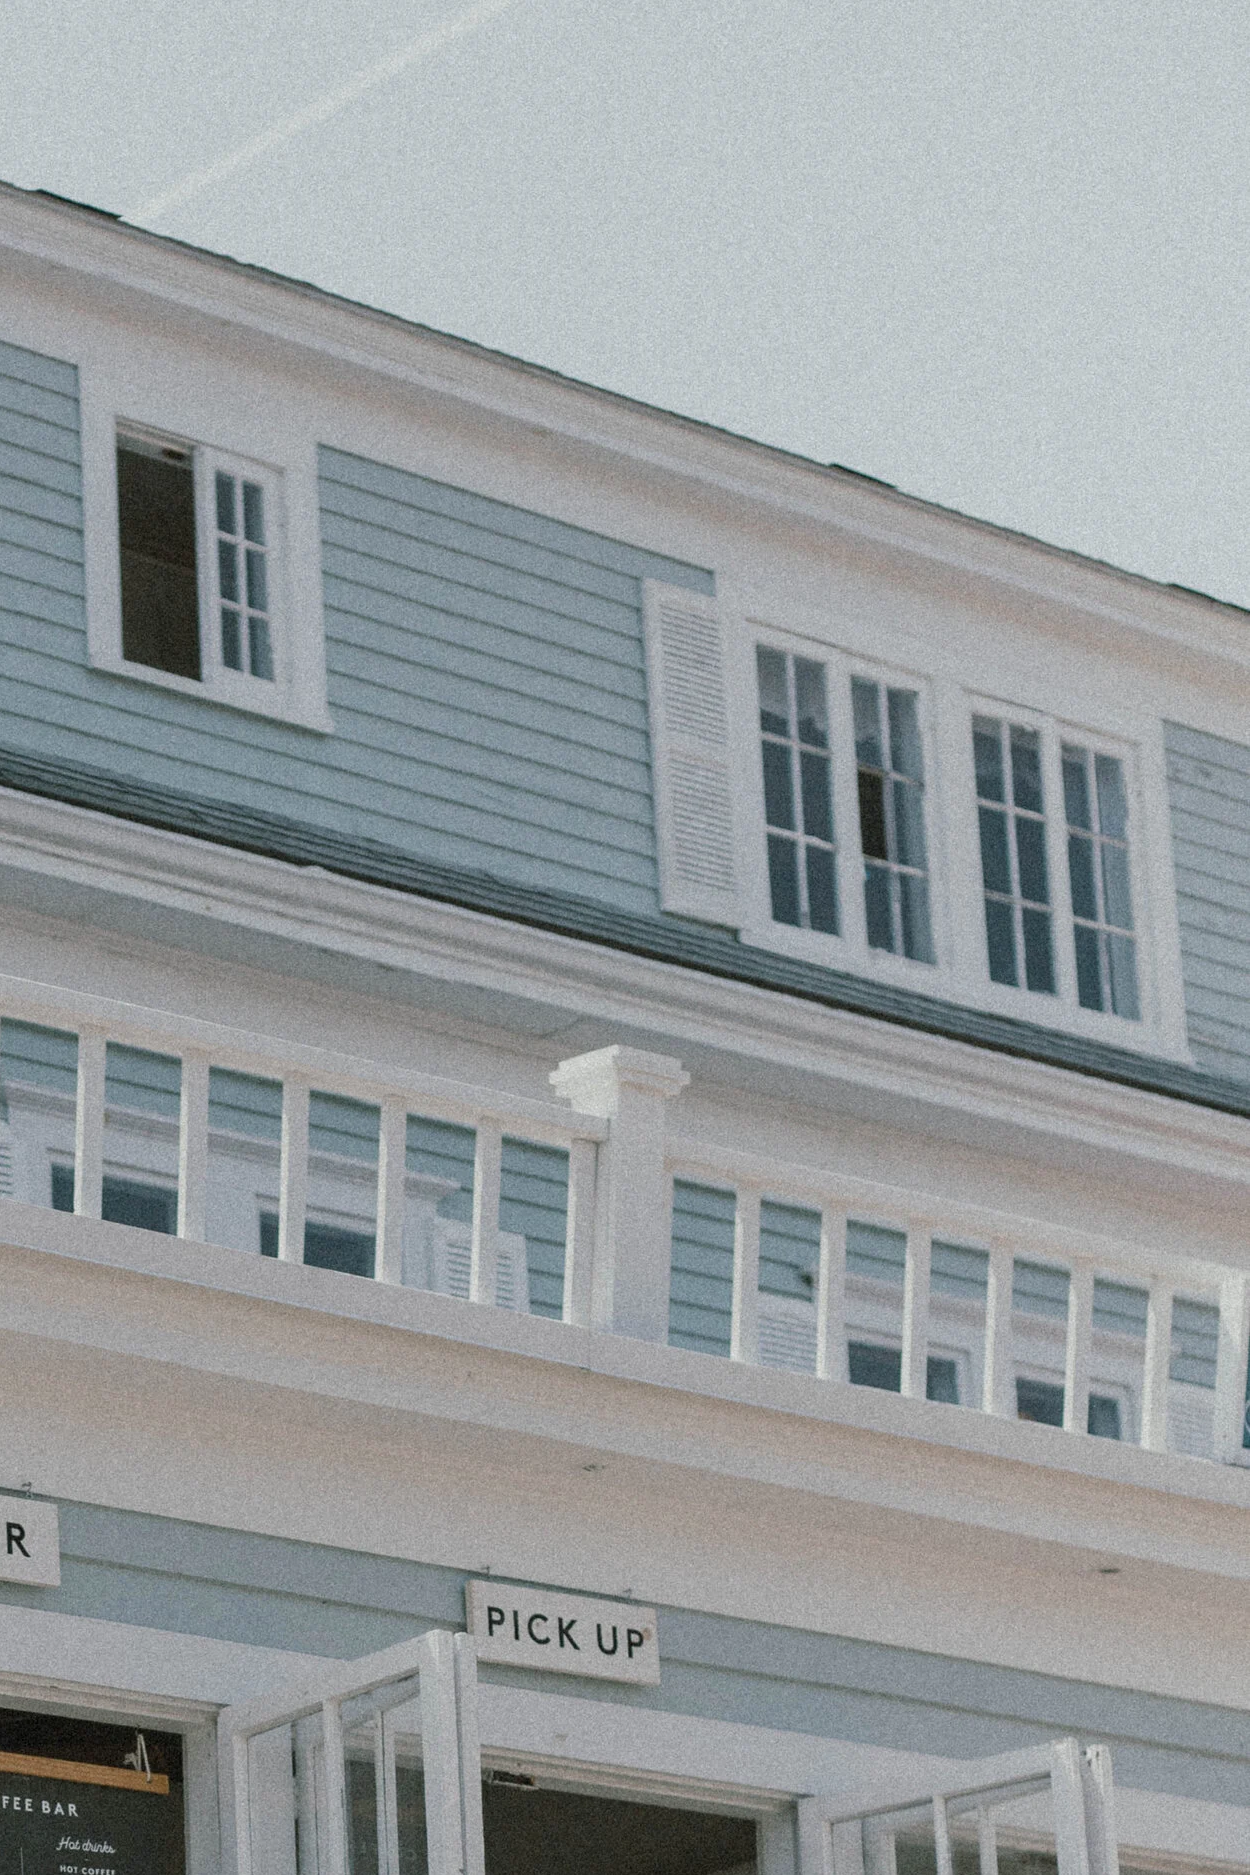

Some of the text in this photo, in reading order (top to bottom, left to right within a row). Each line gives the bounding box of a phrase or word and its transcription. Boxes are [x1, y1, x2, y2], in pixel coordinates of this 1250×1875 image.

[486, 1606, 646, 1661] PICK UP
[41, 1800, 80, 1818] BAR
[56, 1836, 116, 1854] Hot drinks
[59, 1865, 78, 1873] HOT
